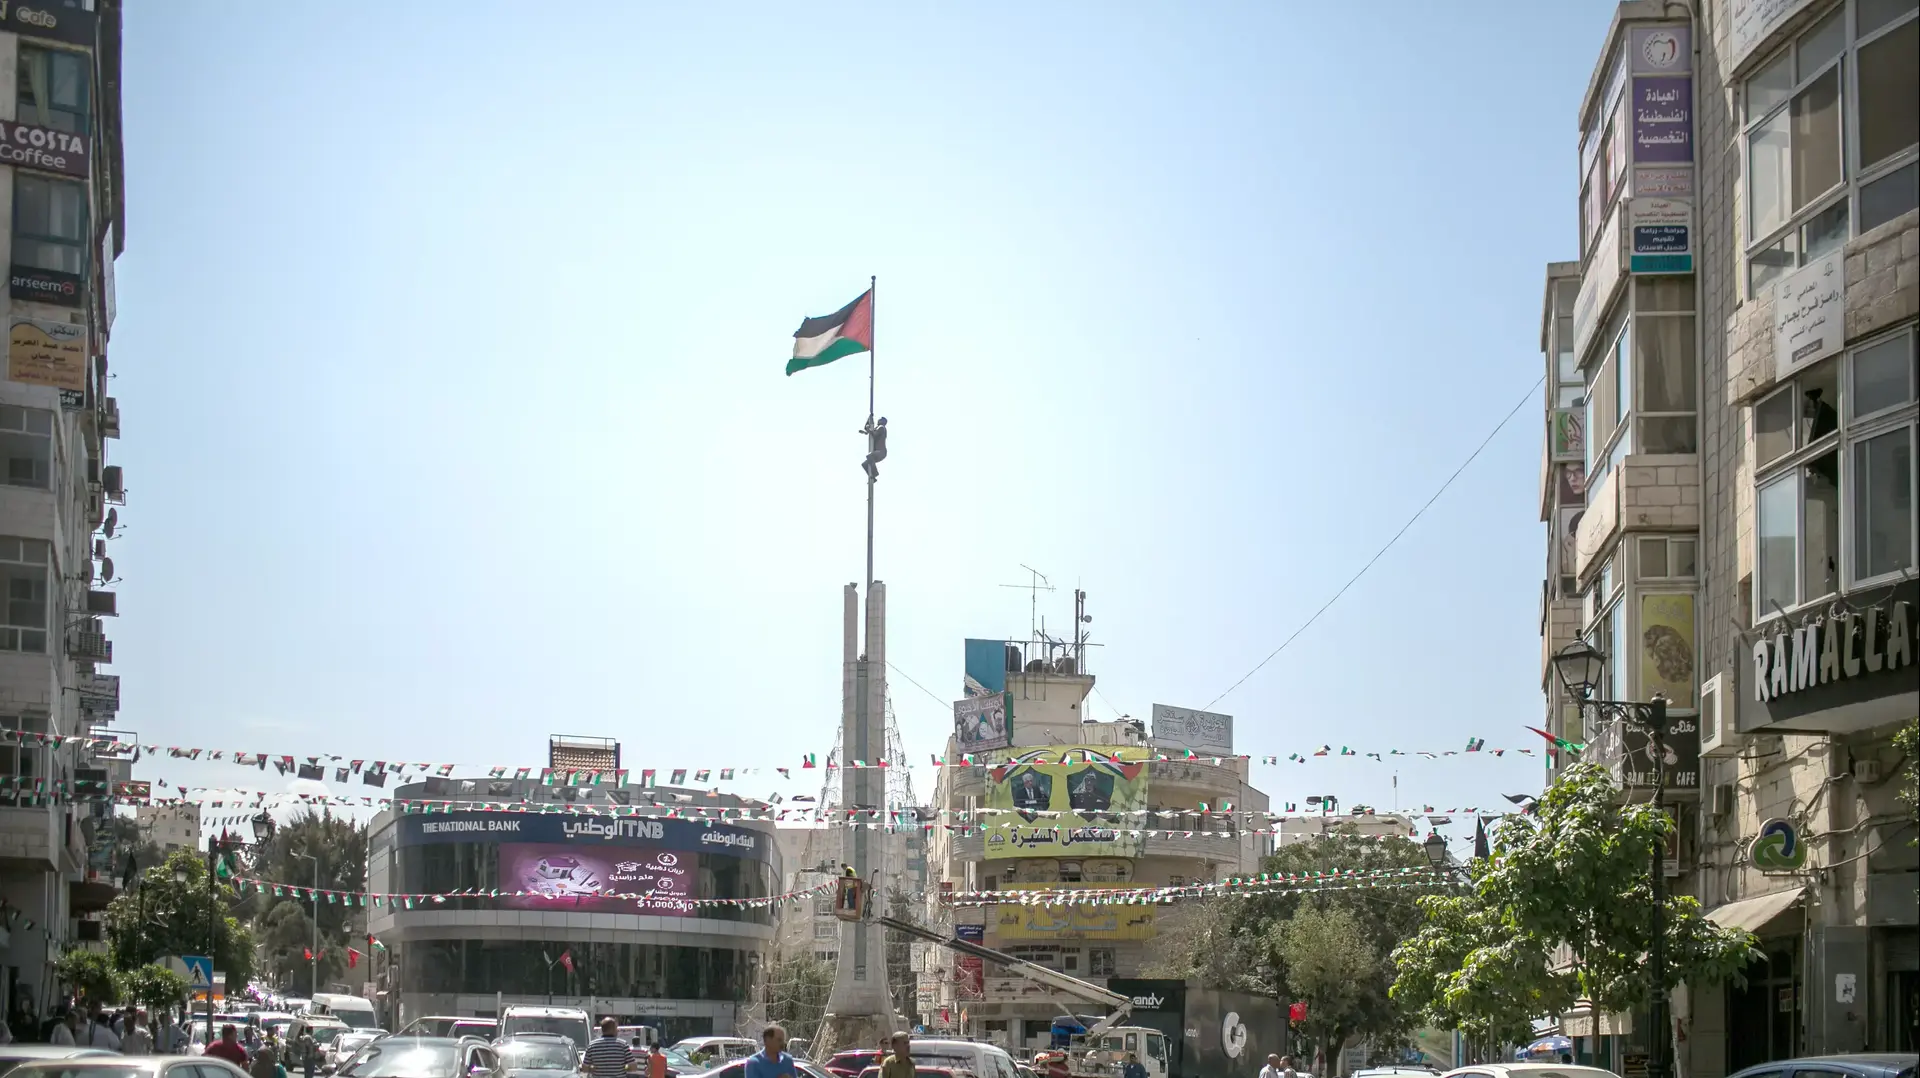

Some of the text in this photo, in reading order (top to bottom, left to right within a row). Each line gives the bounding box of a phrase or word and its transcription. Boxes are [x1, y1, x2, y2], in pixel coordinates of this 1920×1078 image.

[16, 6, 57, 28] Cafe
[1645, 88, 1679, 106] العيادة
[14, 126, 84, 155] COSTA
[1637, 129, 1688, 149] التخصصية
[0, 144, 66, 168] Coffee
[48, 325, 80, 337] الدكتور
[1752, 600, 1919, 703] RAMALLA
[1676, 771, 1696, 786] CAFE
[422, 820, 521, 834] THE NATIONAL BANK
[562, 818, 664, 840] الوطني TNB
[701, 830, 755, 850] البنك الوطني
